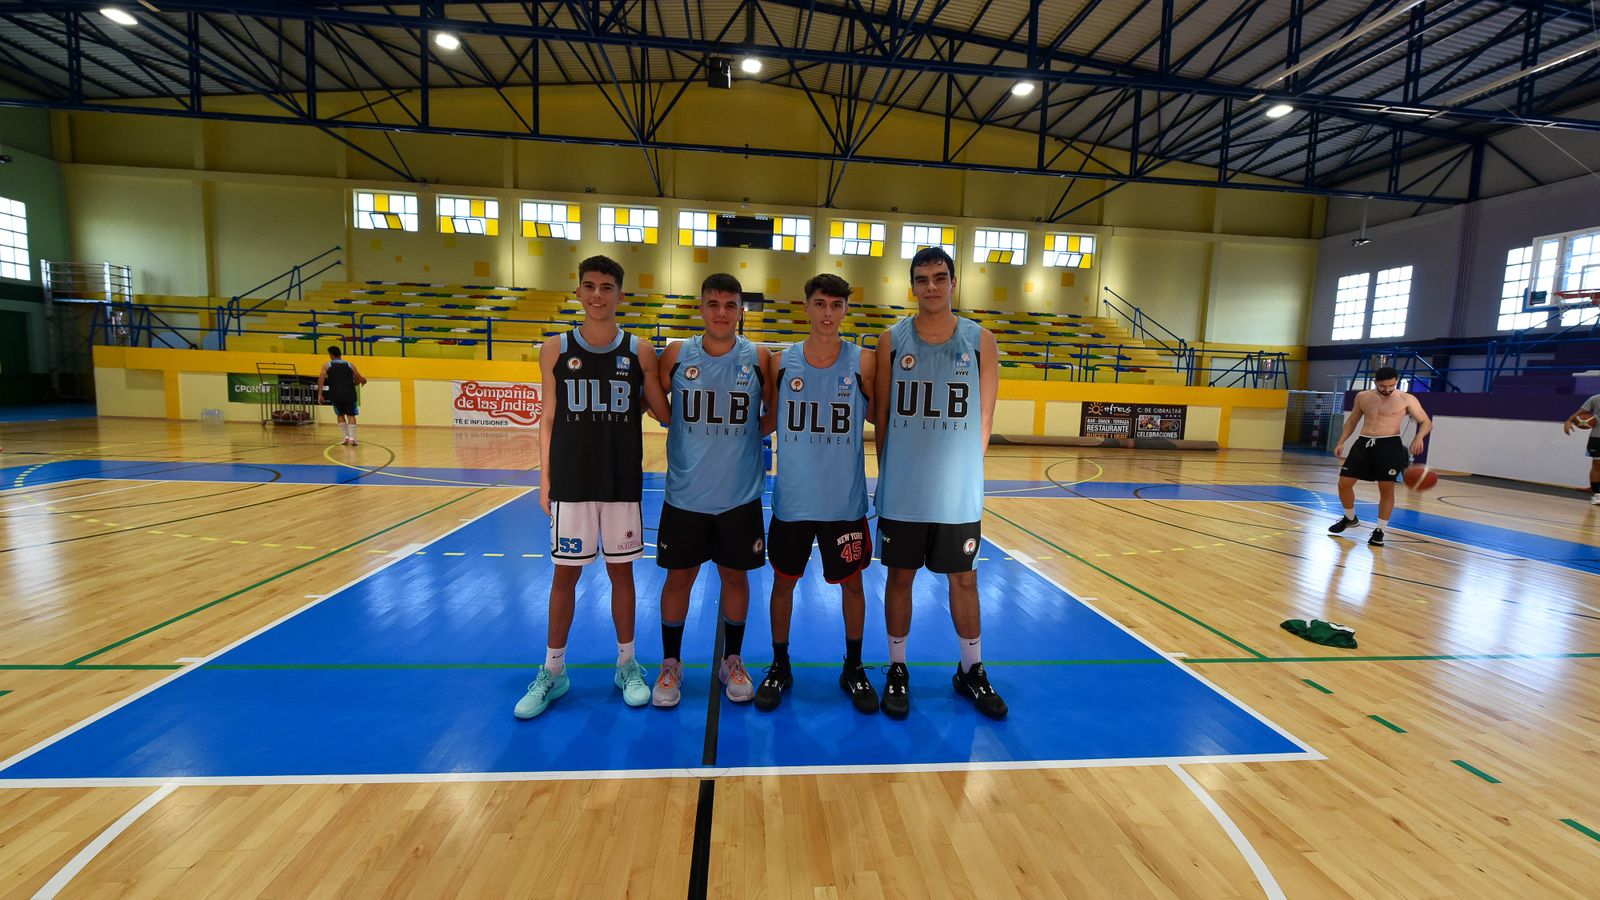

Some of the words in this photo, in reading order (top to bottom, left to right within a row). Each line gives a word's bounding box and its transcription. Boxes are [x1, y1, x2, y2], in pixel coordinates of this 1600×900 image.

[463, 383, 535, 400] Compañía
[564, 379, 631, 413] ULB
[896, 380, 970, 419] ULB
[457, 396, 474, 409] de
[477, 397, 498, 410] las
[500, 399, 543, 415] Indias
[681, 389, 751, 425] ULB
[566, 413, 580, 422] LA
[786, 400, 851, 434] ULB
[893, 418, 908, 428] LA
[680, 424, 692, 435] LA
[1086, 424, 1129, 433] RESTAURANTE
[784, 433, 799, 442] LA
[560, 537, 582, 553] 53
[837, 533, 850, 546] NEW
[850, 532, 864, 540] YORK
[840, 540, 862, 563] 45
